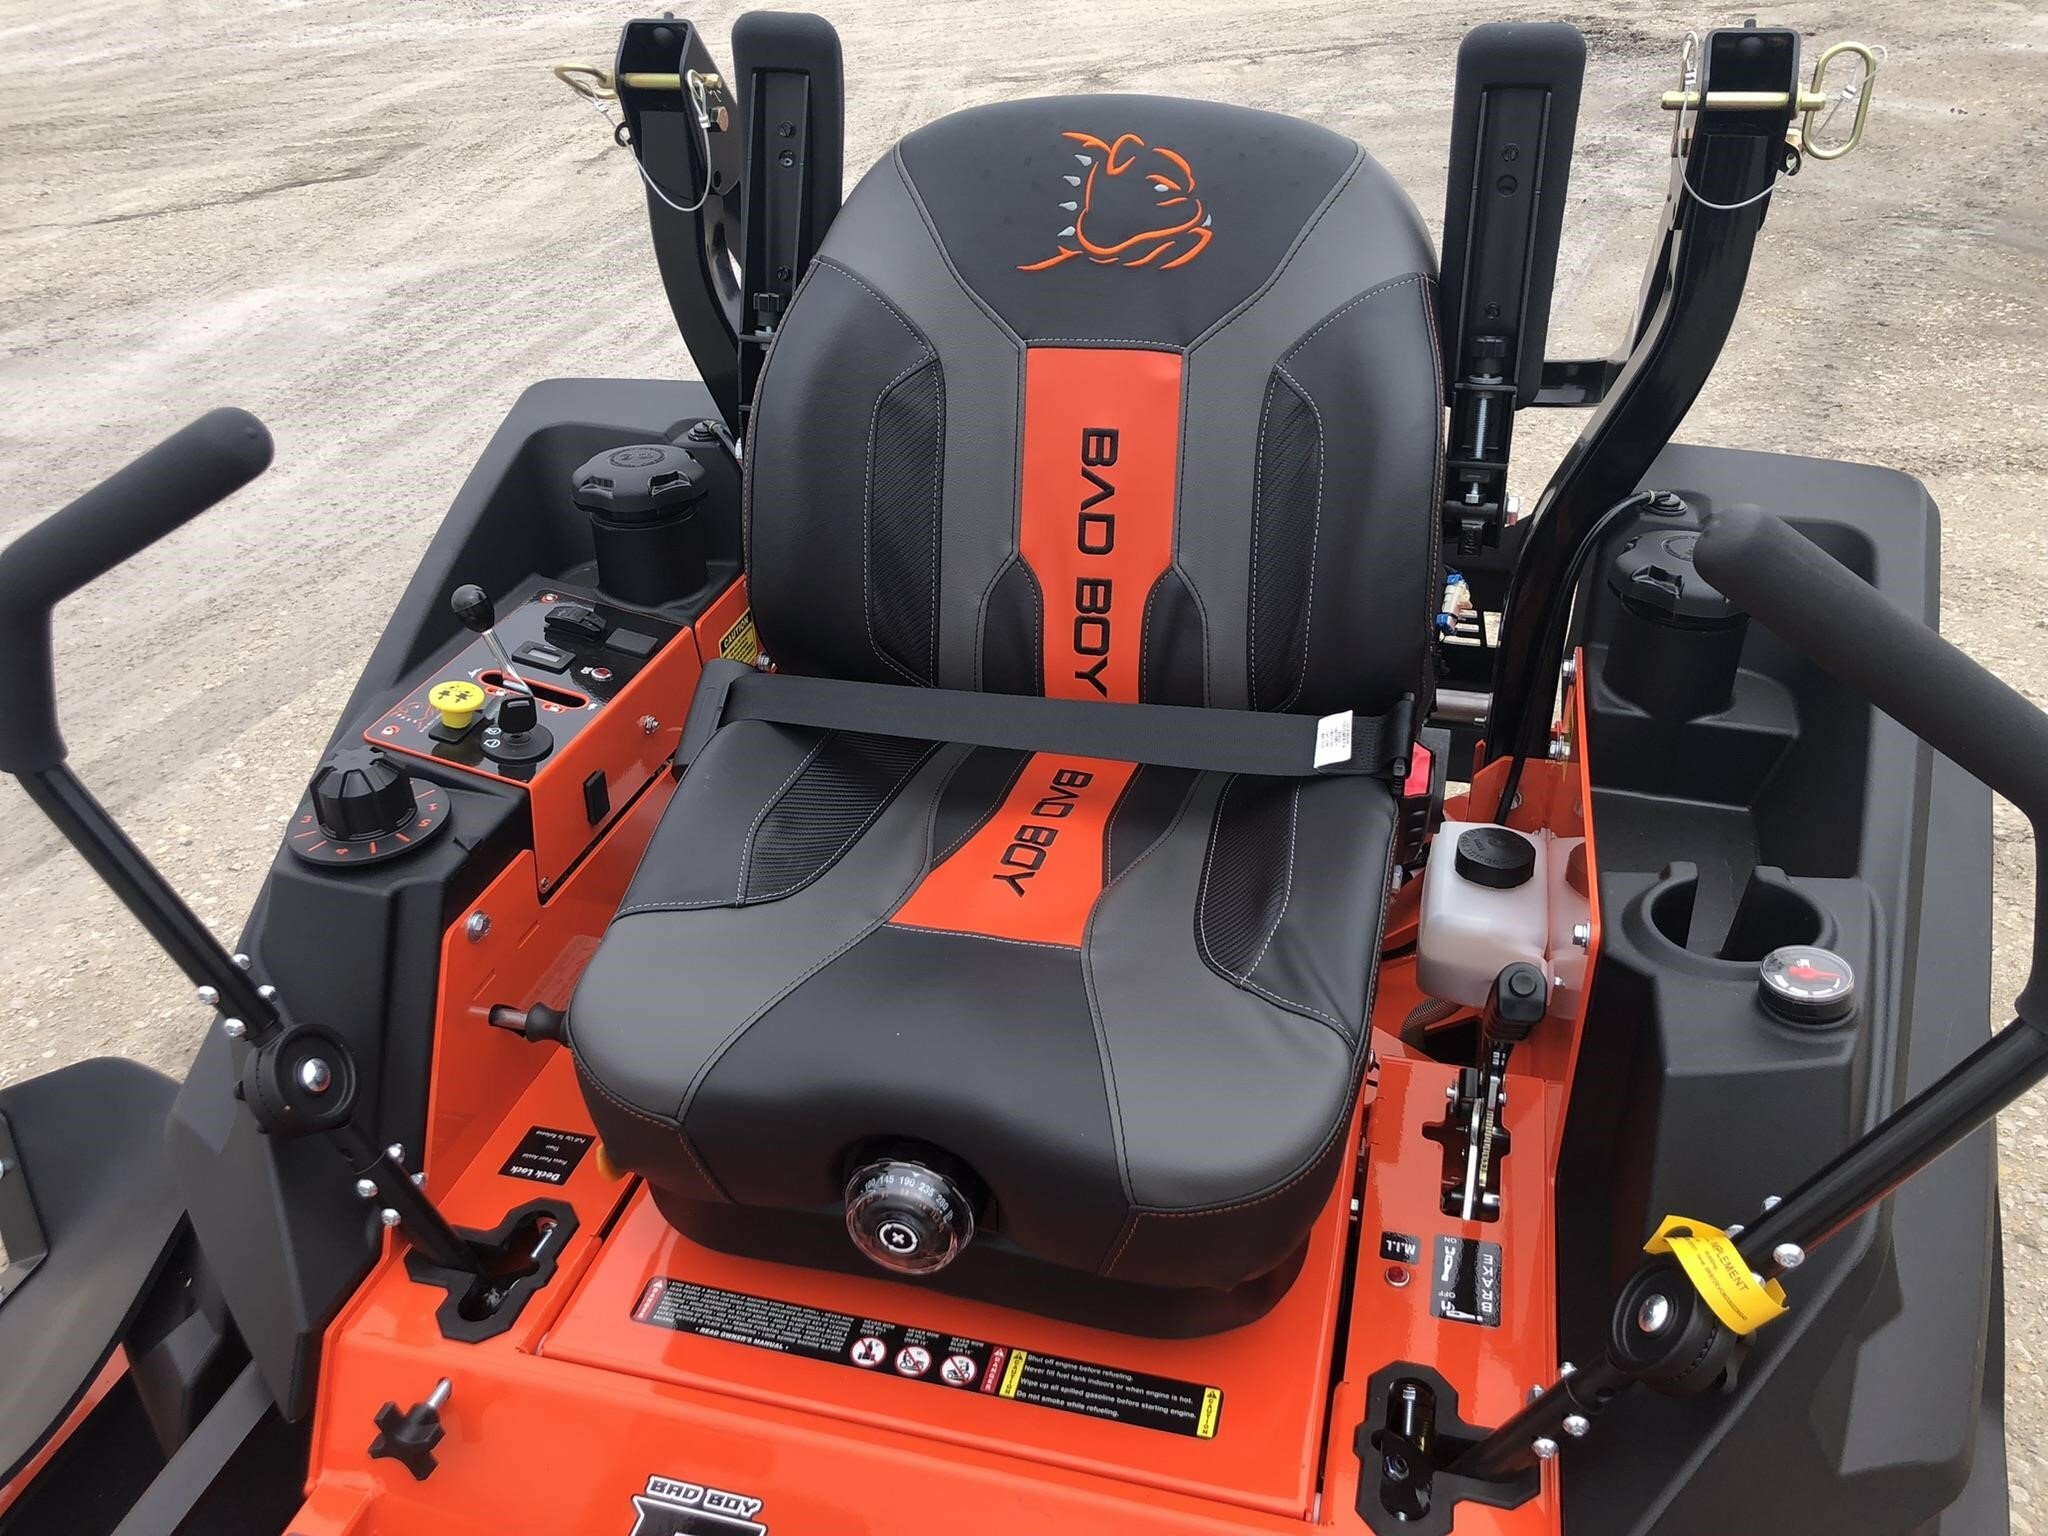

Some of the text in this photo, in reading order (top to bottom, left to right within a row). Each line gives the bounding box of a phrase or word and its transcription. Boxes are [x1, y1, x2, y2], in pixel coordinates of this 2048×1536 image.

[1073, 428, 1119, 699] BAD BOY
[723, 615, 749, 648] CAUTION
[993, 767, 1095, 897] BAD BOY
[509, 1165, 534, 1176] Lock
[918, 1182, 935, 1197] 235
[1444, 1236, 1457, 1244] ON
[1438, 1291, 1456, 1299] OFF
[1481, 1254, 1493, 1313] BRAKE
[698, 1326, 720, 1336] READ
[752, 1337, 784, 1348] MANUAL
[1054, 1360, 1078, 1370] engine
[1024, 1364, 1045, 1374] Never
[1144, 1389, 1170, 1400] engine
[1016, 1390, 1026, 1398] Do
[1028, 1392, 1040, 1400] not
[1041, 1395, 1065, 1405] smoke
[1202, 1399, 1214, 1434] CAUTION
[650, 1478, 758, 1514] BAD BOY
